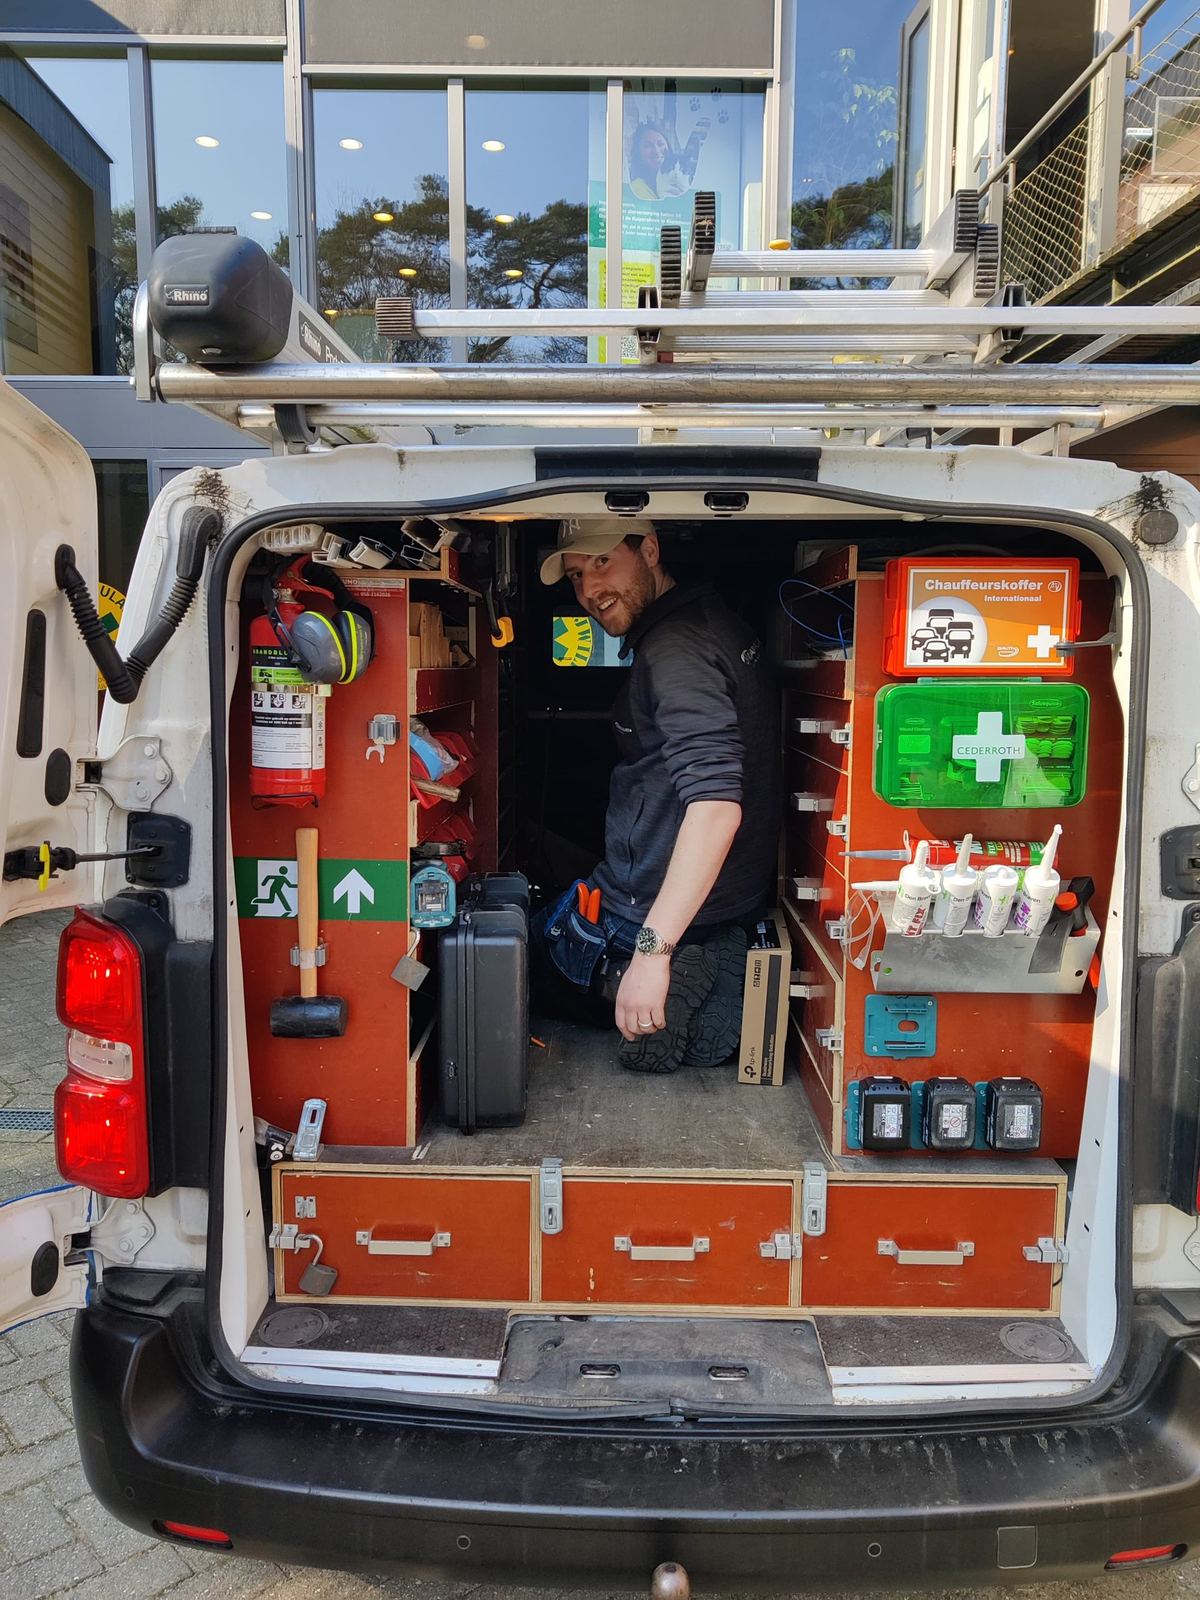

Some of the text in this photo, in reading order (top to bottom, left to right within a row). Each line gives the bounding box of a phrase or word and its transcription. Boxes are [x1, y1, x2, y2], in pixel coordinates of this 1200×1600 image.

[174, 290, 208, 301] Rhino
[924, 578, 1044, 592] Chauffeurskoffer
[983, 594, 1042, 603] Internationaal
[957, 746, 1021, 755] CEDERROTH
[904, 893, 917, 902] Den
